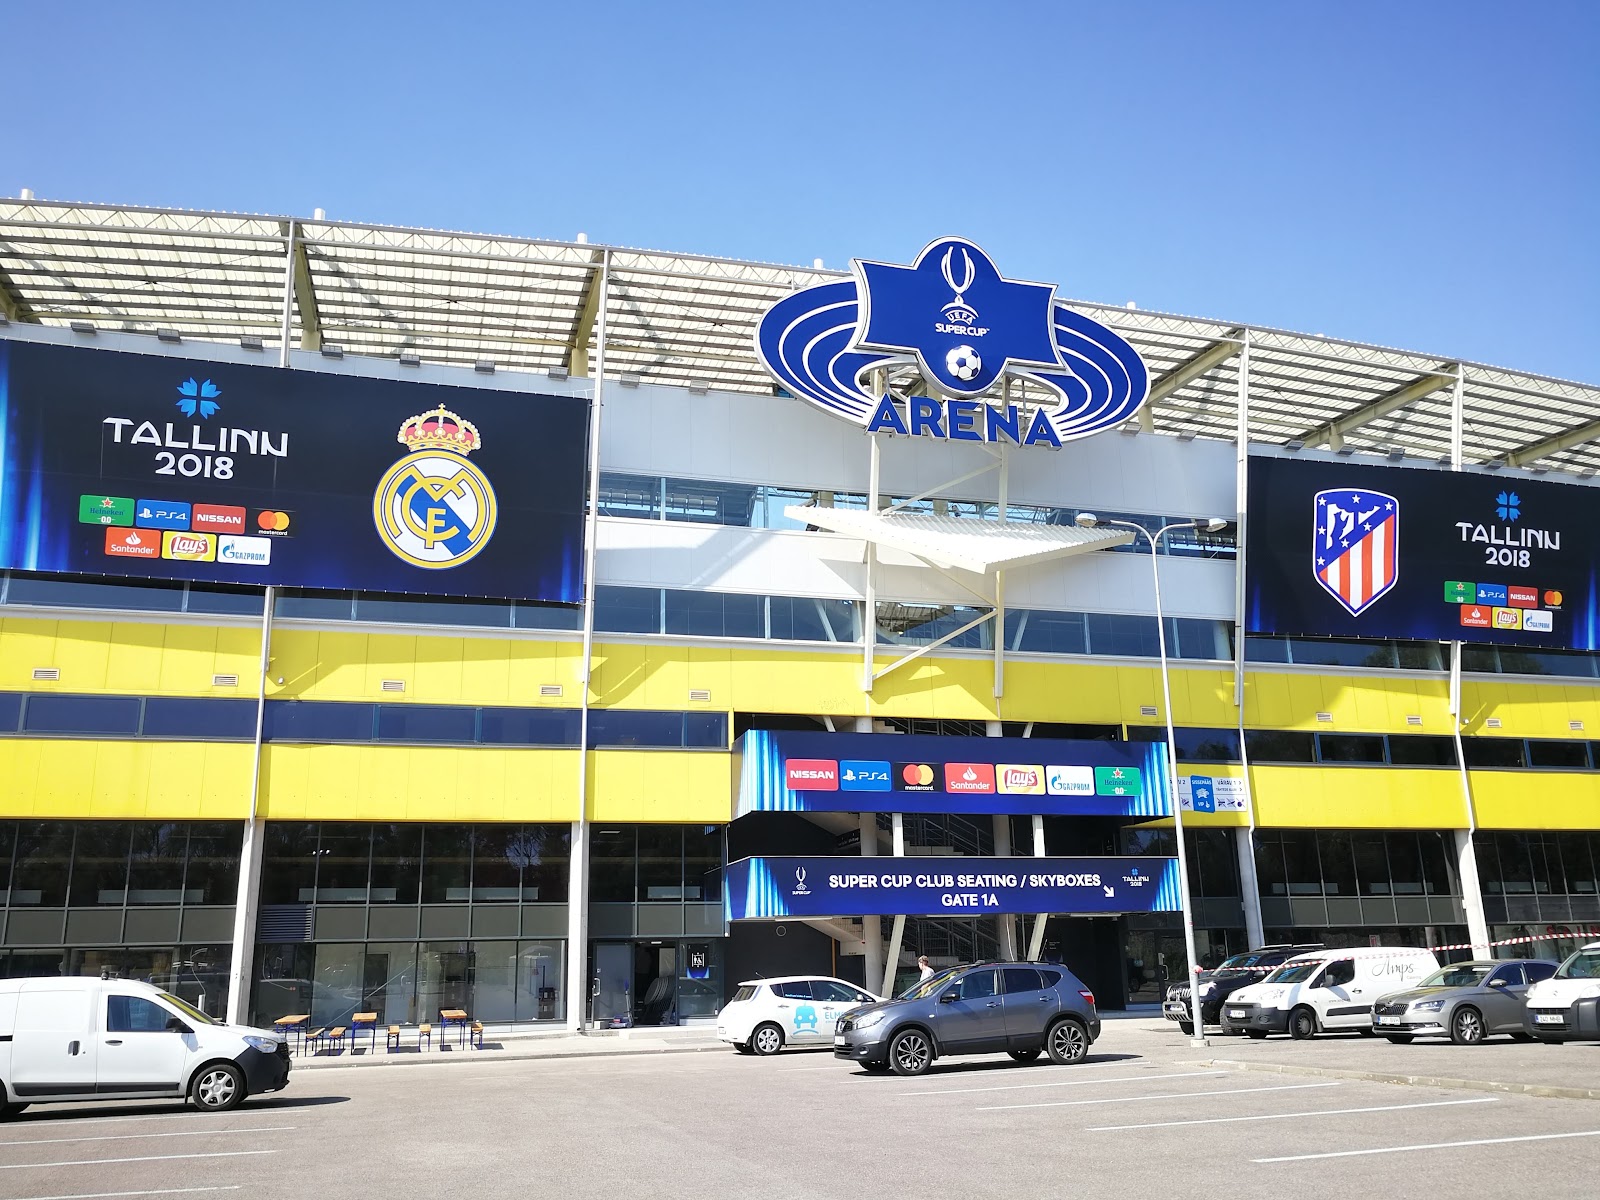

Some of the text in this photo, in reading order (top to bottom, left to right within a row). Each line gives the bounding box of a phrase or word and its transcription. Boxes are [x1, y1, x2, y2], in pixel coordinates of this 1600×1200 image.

[947, 311, 973, 325] UEFA
[866, 392, 1063, 450] ARENA
[103, 417, 289, 457] TALLINN
[155, 452, 234, 480] 2018
[90, 508, 124, 516] Heineken
[156, 510, 187, 520] PS4
[197, 513, 242, 524] NISSAN
[1455, 522, 1560, 550] TALLINN
[111, 544, 154, 554] Santander
[1485, 547, 1531, 568] 2018
[1510, 593, 1536, 601] NISSAN
[1463, 617, 1489, 625] Santander
[790, 770, 834, 779] NISSAN
[858, 771, 889, 780] PS4
[951, 781, 990, 790] Santander
[829, 873, 1101, 888] SUPER CUP CLUB SEATING / SKYBOXES
[941, 893, 999, 907] GATE 1A
